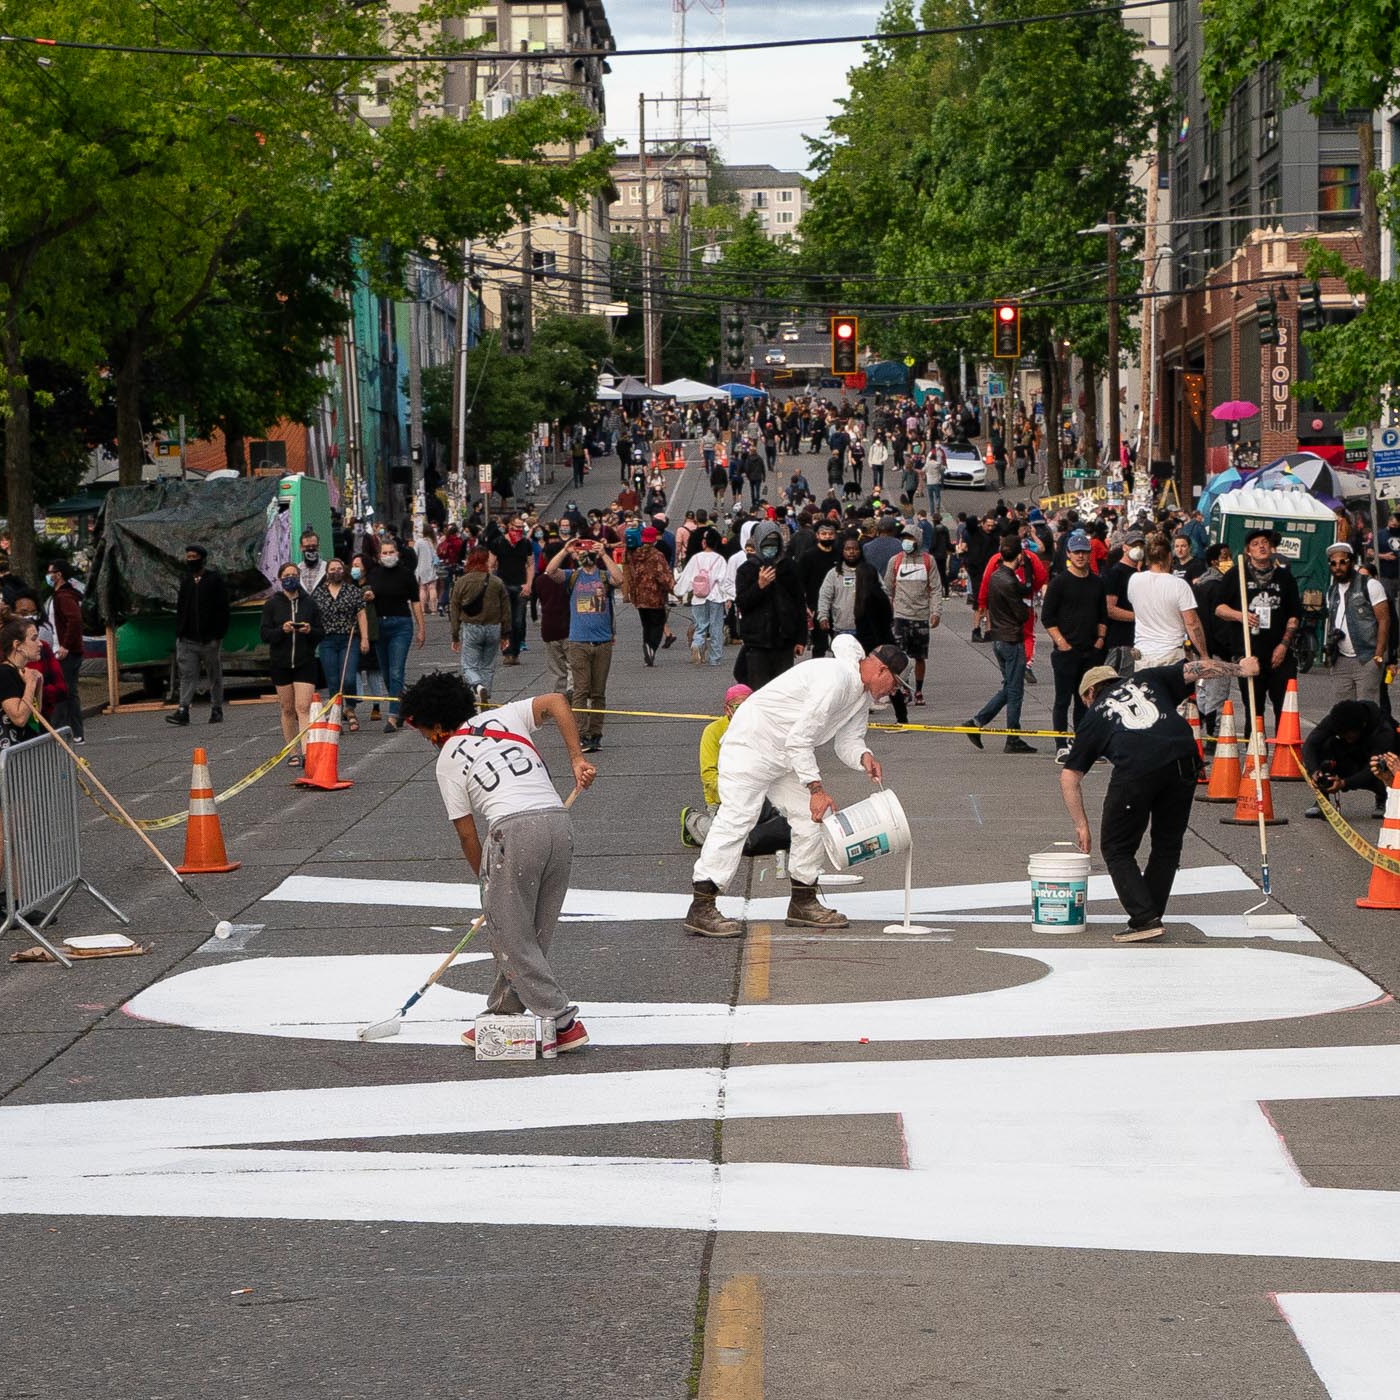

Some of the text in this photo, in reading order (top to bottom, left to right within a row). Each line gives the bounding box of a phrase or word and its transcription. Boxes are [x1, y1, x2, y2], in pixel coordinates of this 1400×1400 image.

[1271, 326, 1290, 422] STOUT
[1386, 433, 1396, 444] P
[1035, 889, 1074, 898] DRYLOK
[476, 1023, 506, 1046] WHITE CLAW
